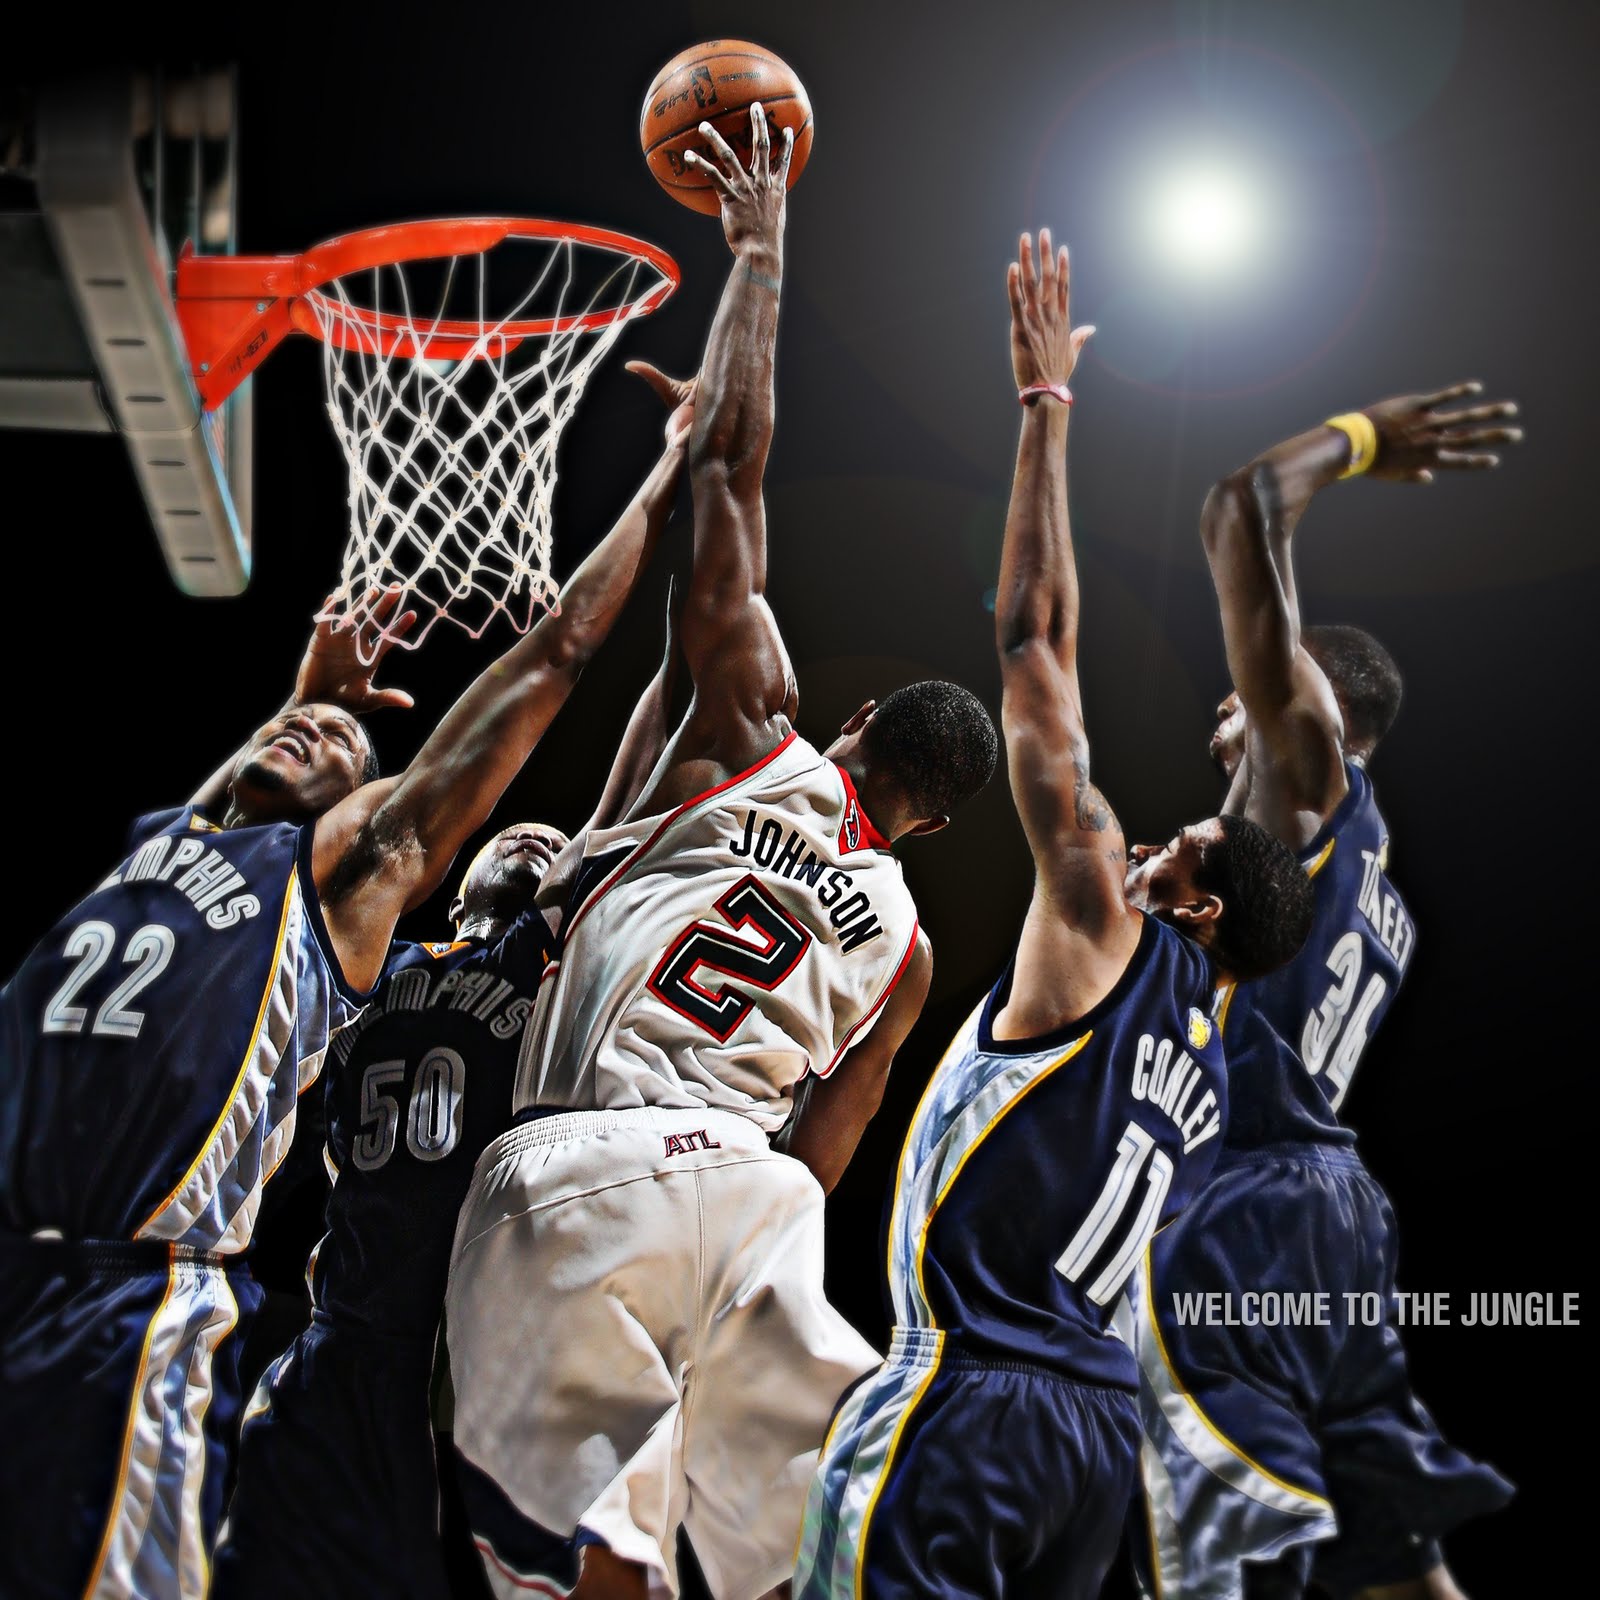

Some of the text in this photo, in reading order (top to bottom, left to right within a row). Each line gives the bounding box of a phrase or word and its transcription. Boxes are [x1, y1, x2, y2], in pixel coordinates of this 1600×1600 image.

[730, 810, 883, 955] JOHNSON
[43, 921, 175, 1037] 22
[646, 873, 811, 1043] 2
[1301, 932, 1386, 1114] 34
[352, 1047, 465, 1171] 50
[663, 1129, 722, 1158] ATL
[1131, 1034, 1220, 1155] CONLEY
[1054, 1120, 1174, 1306] 11
